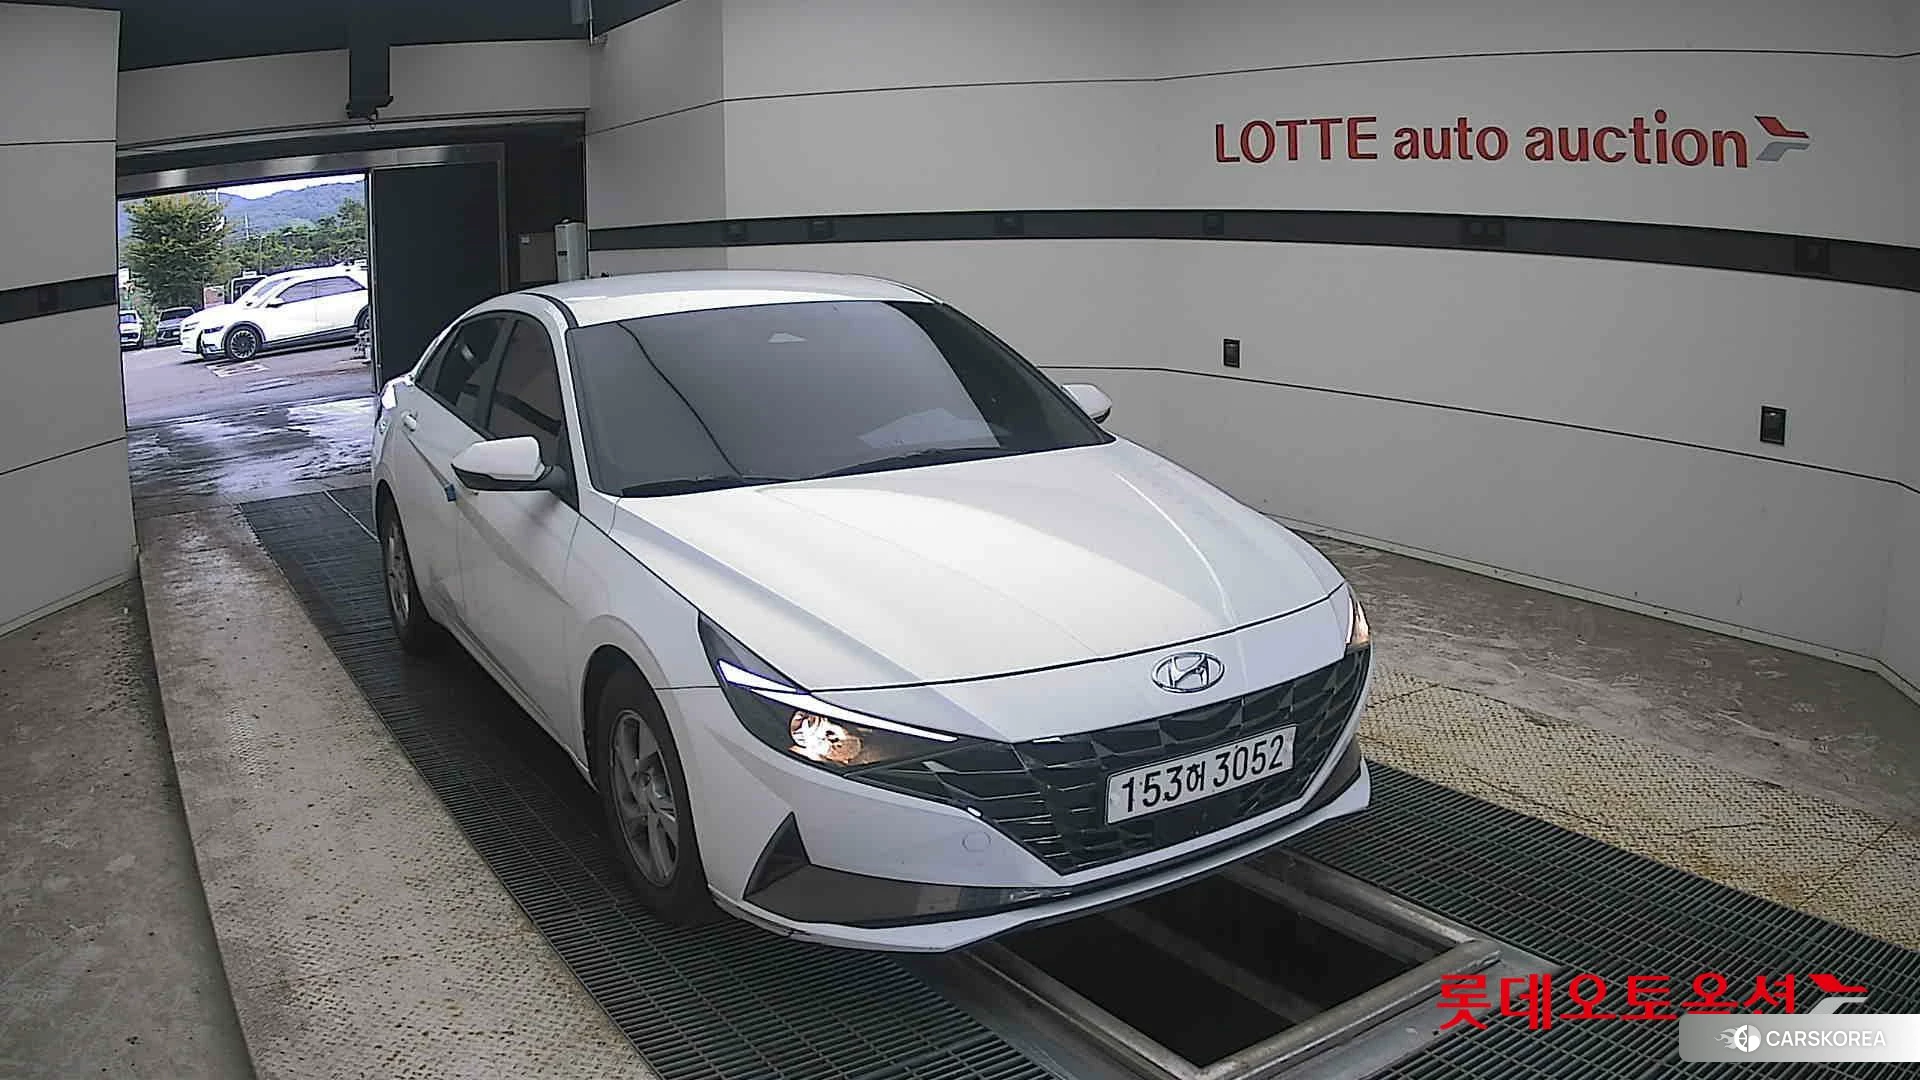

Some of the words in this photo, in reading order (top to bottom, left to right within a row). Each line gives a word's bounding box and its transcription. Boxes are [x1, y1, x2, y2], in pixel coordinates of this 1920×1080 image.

[1215, 116, 1378, 163] LOTTE
[1393, 117, 1509, 161] auto
[1524, 109, 1749, 168] auction
[1122, 761, 1206, 812] 153허
[1213, 734, 1284, 788] 3052
